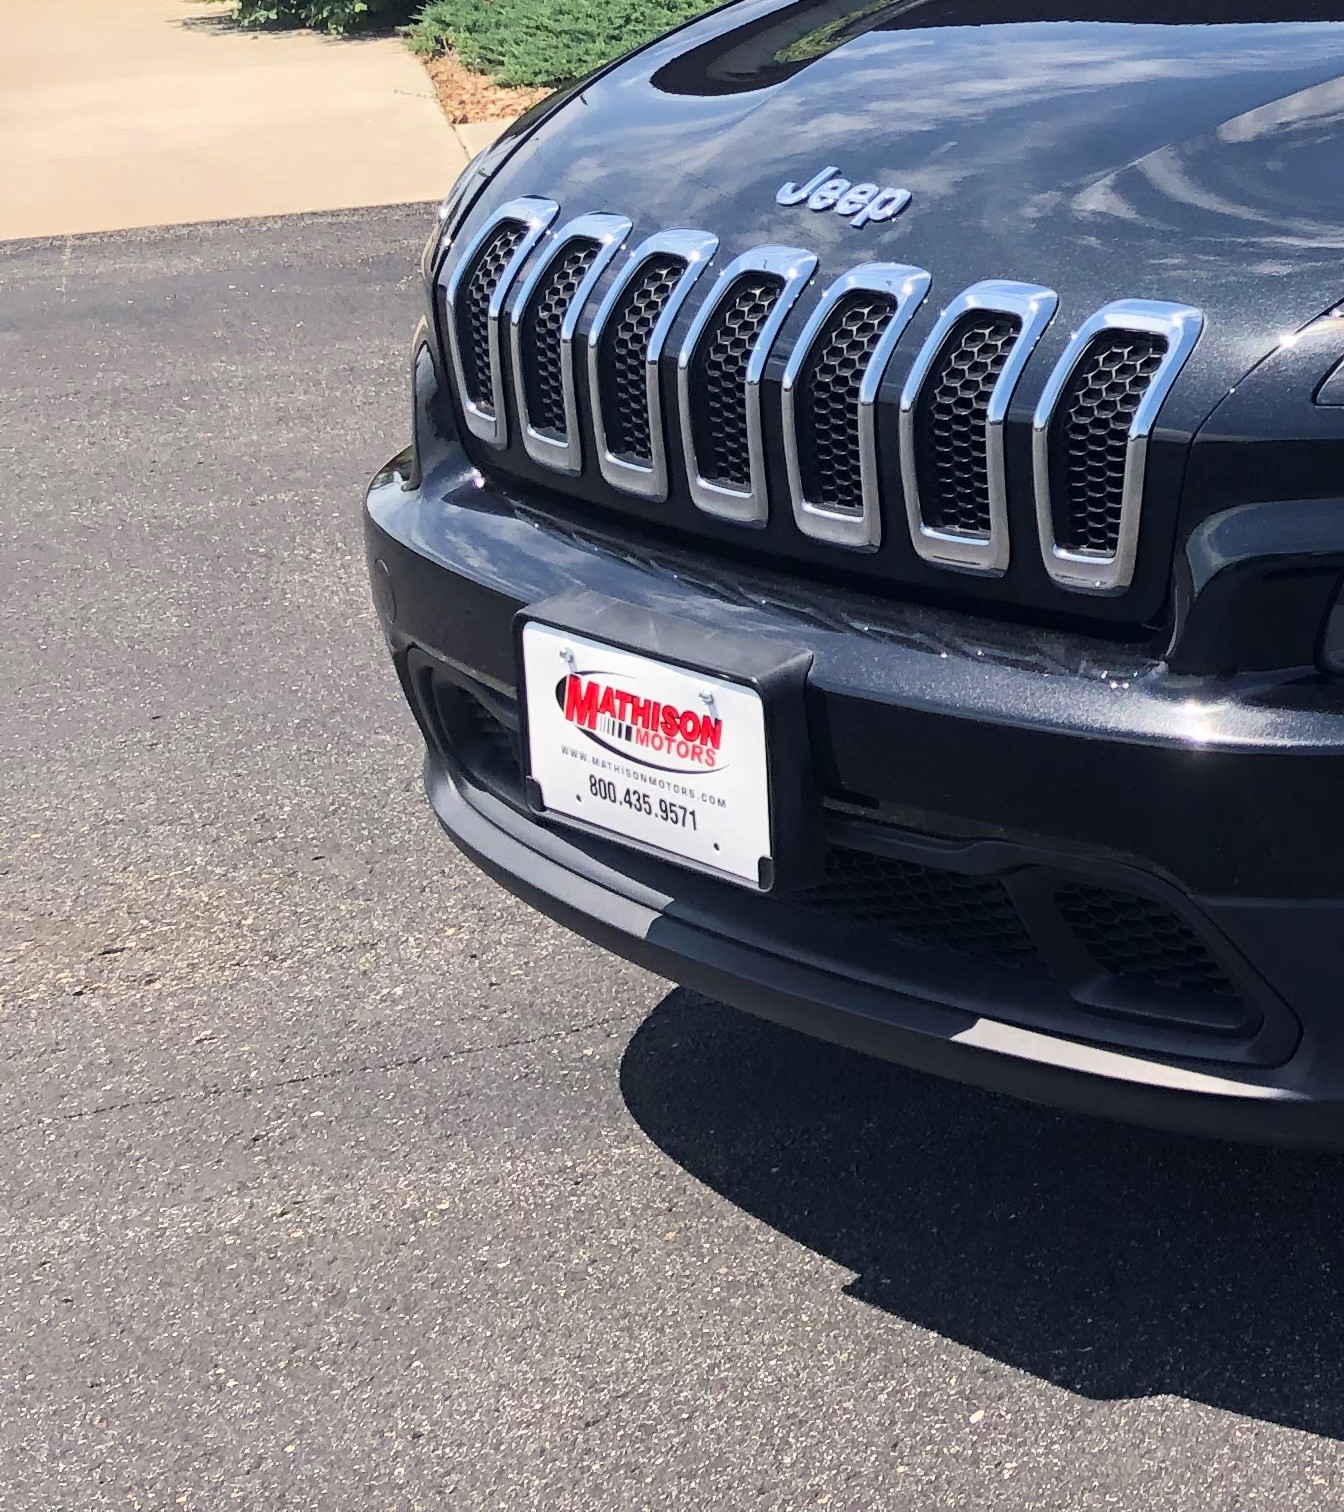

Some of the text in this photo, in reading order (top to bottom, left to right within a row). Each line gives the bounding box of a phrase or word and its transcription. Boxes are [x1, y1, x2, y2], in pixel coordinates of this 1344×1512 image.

[775, 165, 912, 228] Jeep
[565, 673, 723, 750] MATHISON
[635, 727, 717, 768] MOTORS
[588, 774, 698, 831] 800.435.9571
